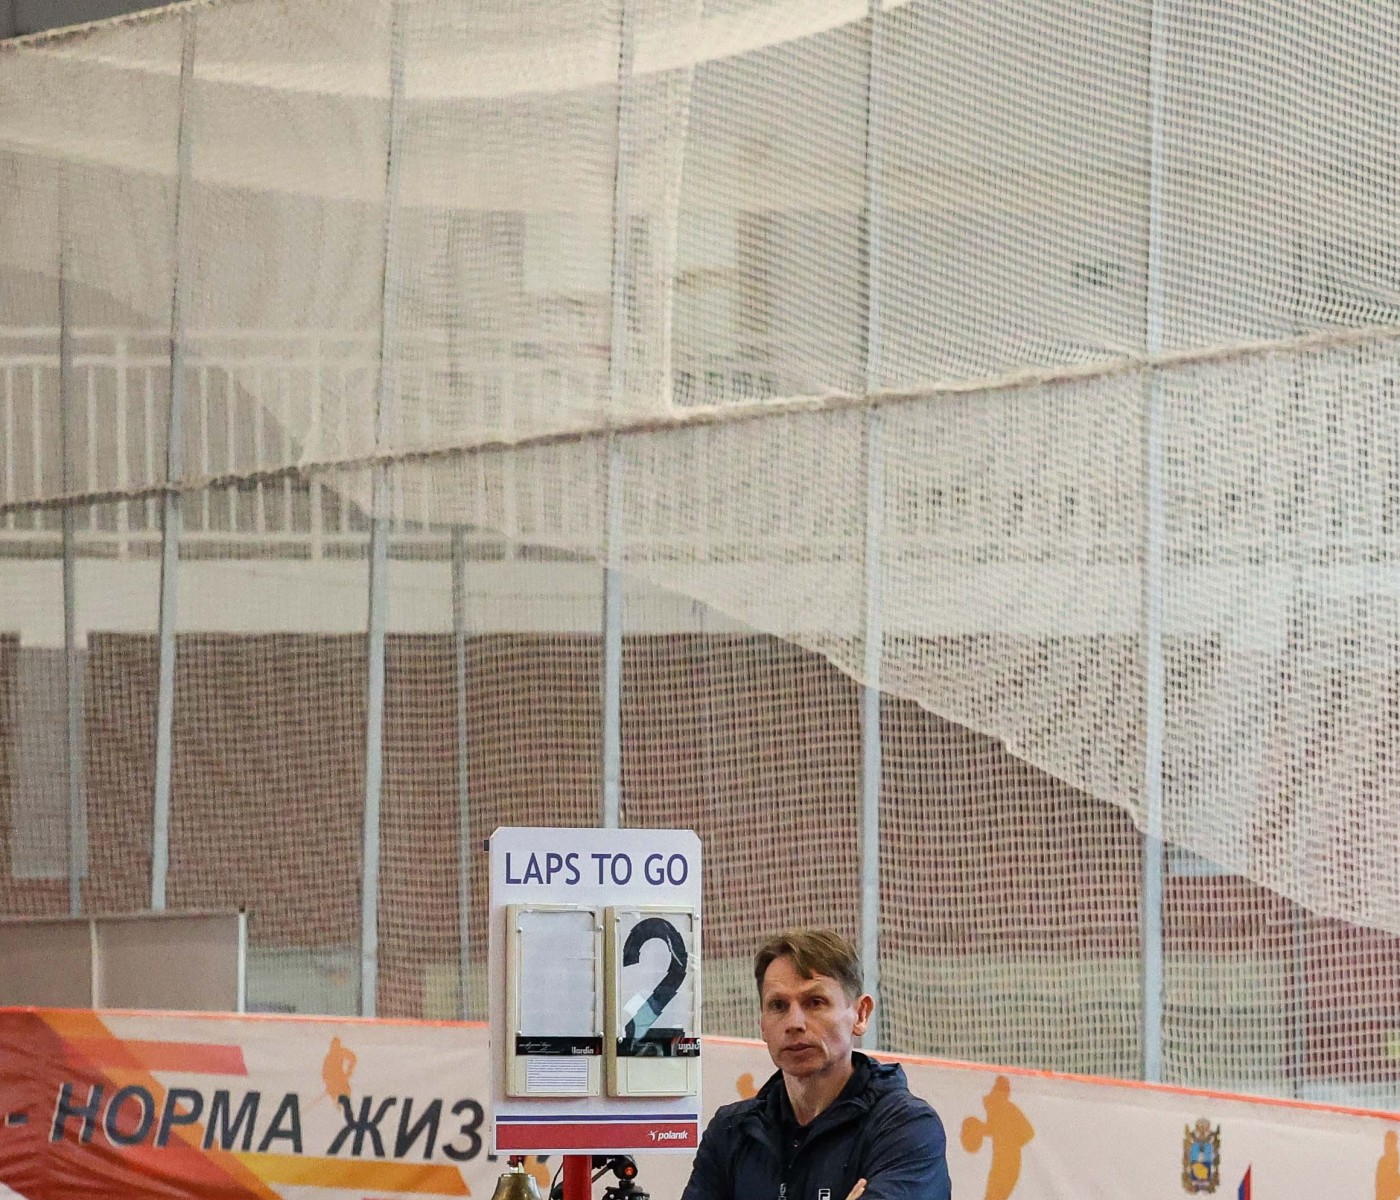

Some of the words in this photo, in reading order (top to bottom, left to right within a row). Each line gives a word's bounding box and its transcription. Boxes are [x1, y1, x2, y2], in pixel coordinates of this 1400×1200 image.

[505, 852, 581, 886] LAPS
[591, 853, 633, 886] TO
[644, 853, 689, 886] GO
[623, 917, 688, 1050] 2
[49, 1082, 303, 1154] НОРМА
[327, 1094, 550, 1163] ЖИЗ
[657, 1130, 689, 1142] polanik
